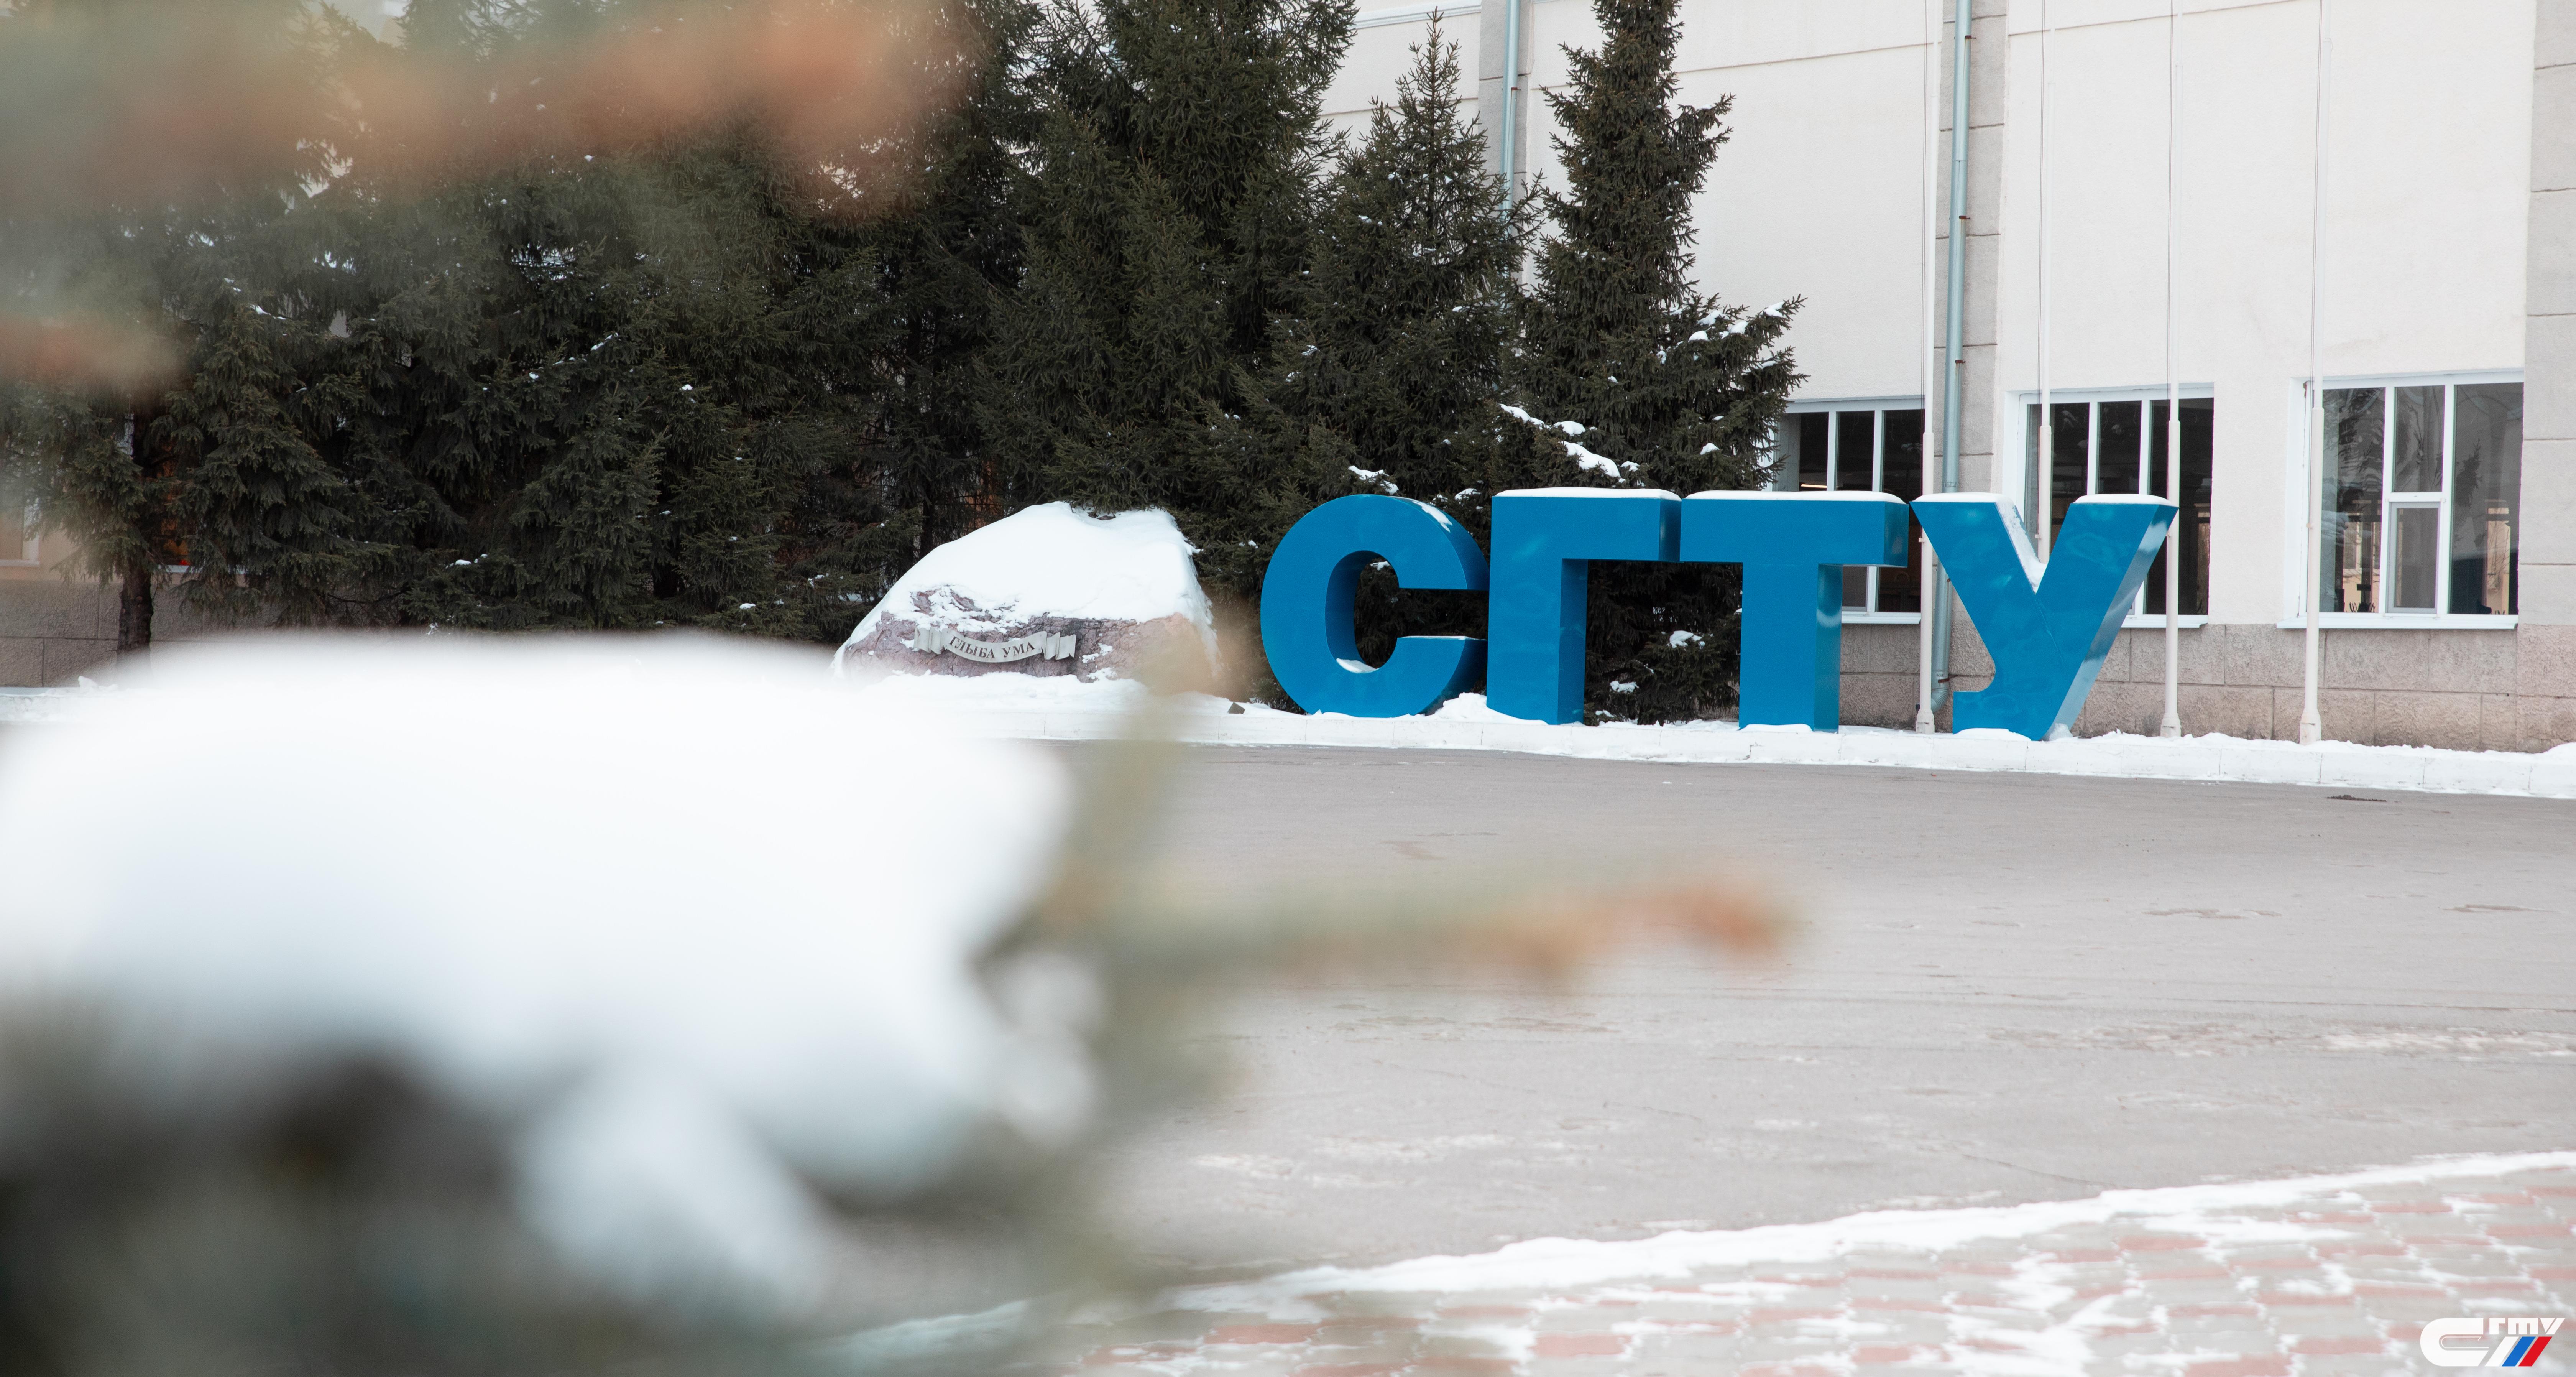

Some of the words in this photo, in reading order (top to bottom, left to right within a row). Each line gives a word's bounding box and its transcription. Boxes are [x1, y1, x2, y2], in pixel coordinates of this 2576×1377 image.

[949, 635, 996, 658] ГЛЫБА
[1002, 641, 1035, 658] УМА
[1260, 489, 2180, 741] СГТУ
